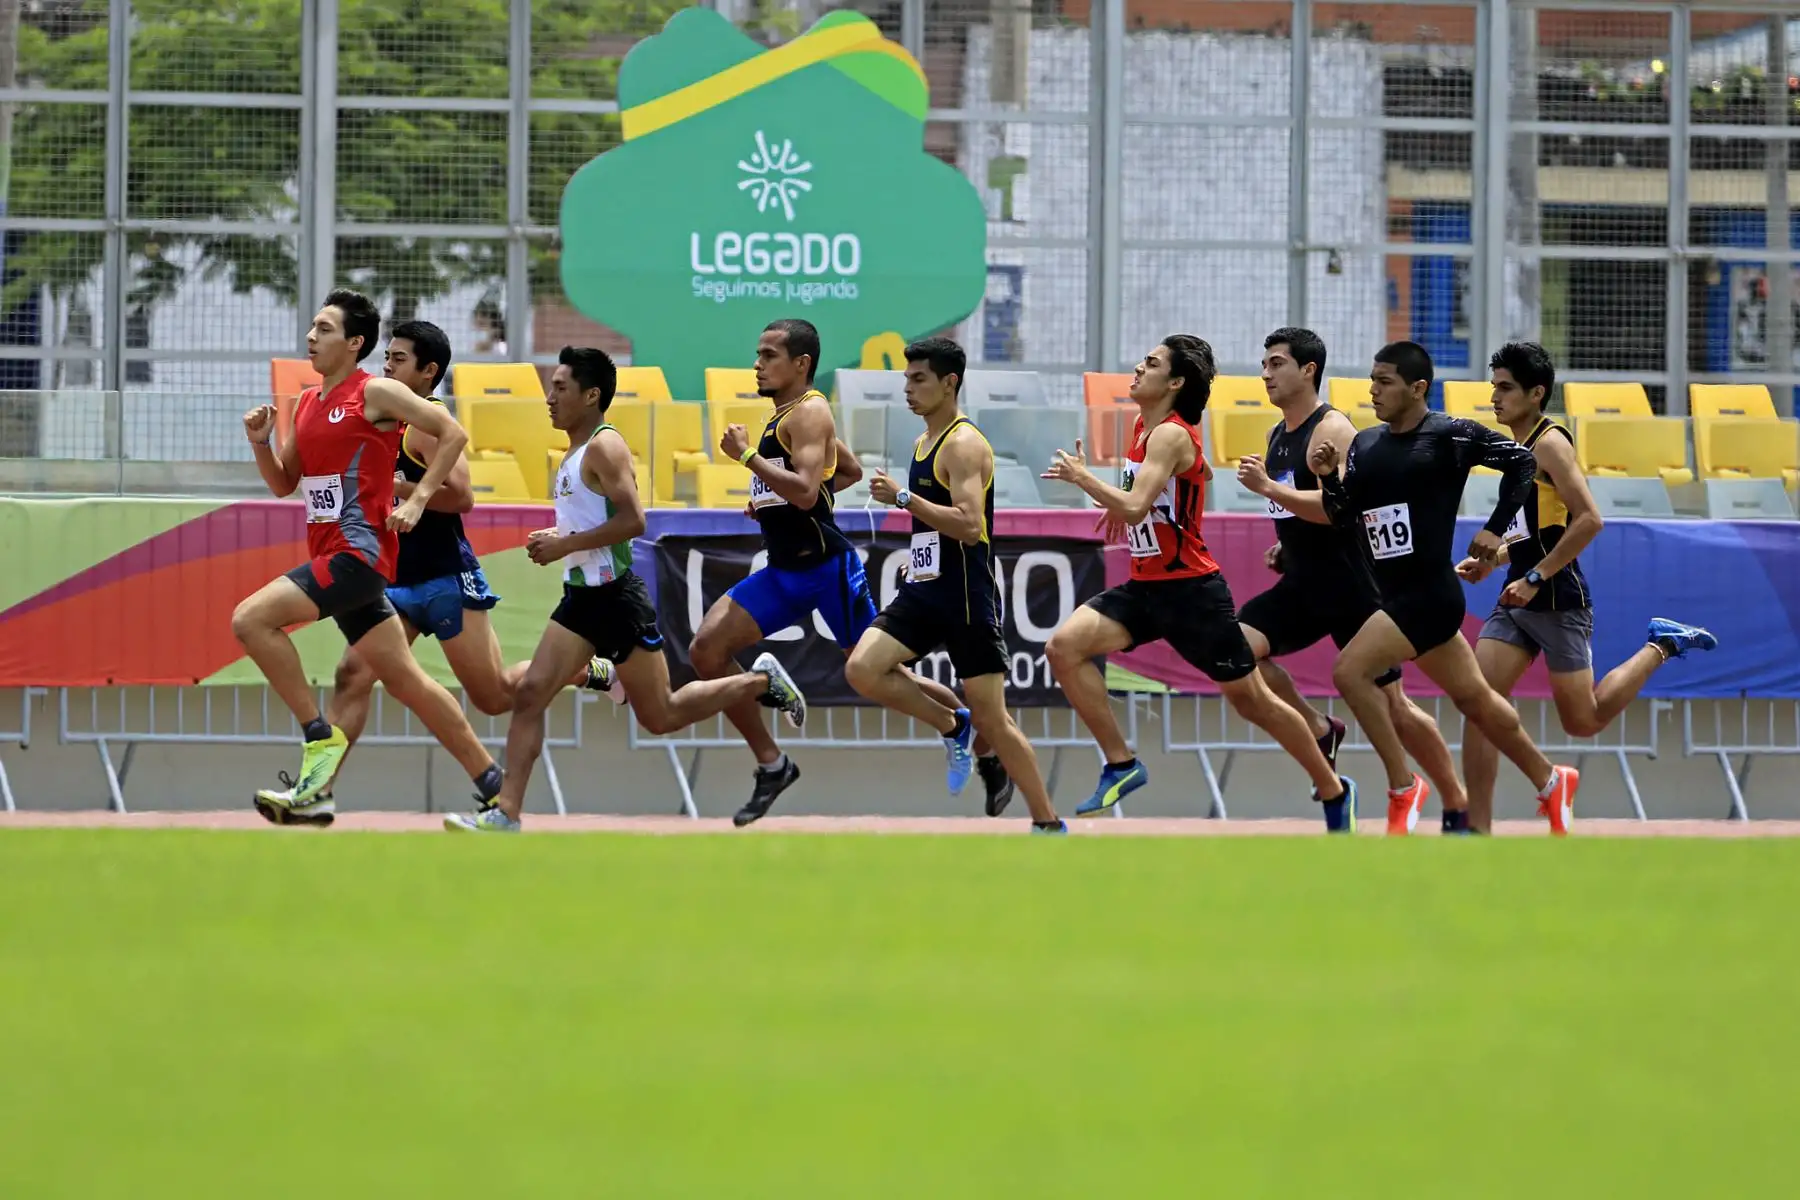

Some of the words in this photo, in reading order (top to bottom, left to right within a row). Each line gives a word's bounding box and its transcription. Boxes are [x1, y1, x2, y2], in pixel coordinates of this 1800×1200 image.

[692, 275, 782, 303] Seguimos
[309, 489, 336, 510] 359
[1368, 521, 1409, 551] 519
[911, 546, 933, 569] 358
